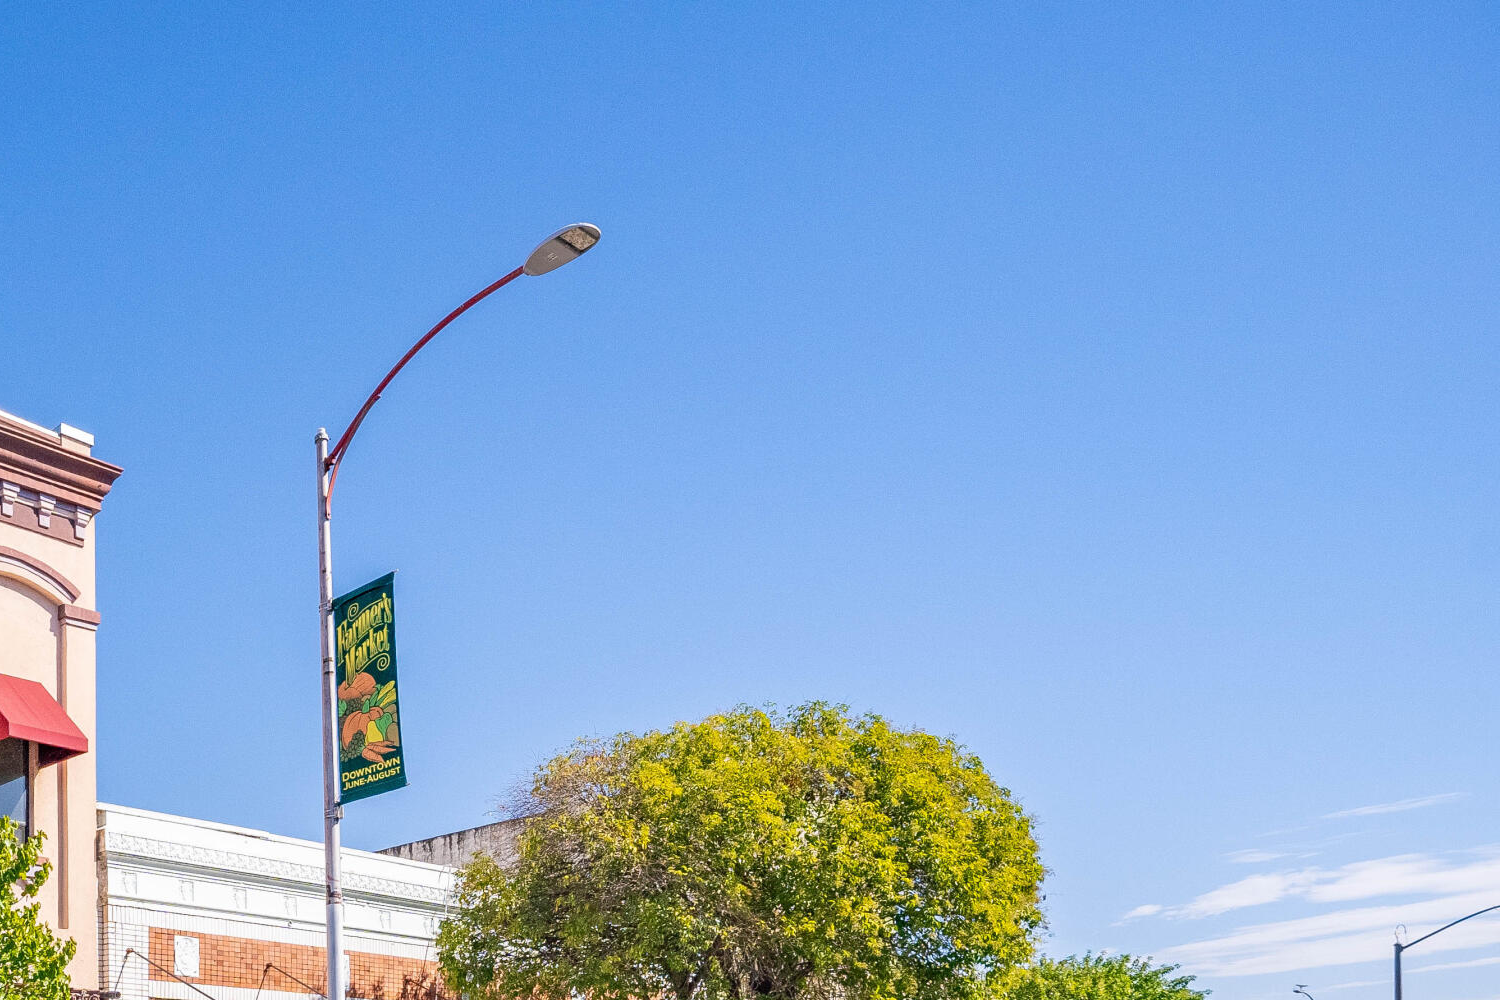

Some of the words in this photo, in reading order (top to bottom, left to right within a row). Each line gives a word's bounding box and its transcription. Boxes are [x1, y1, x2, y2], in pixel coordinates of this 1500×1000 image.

[336, 593, 392, 667] Farmer's
[345, 623, 389, 686] Market
[342, 756, 401, 782] DOWNTOWN
[343, 766, 401, 790] JUNE-AUGUST
